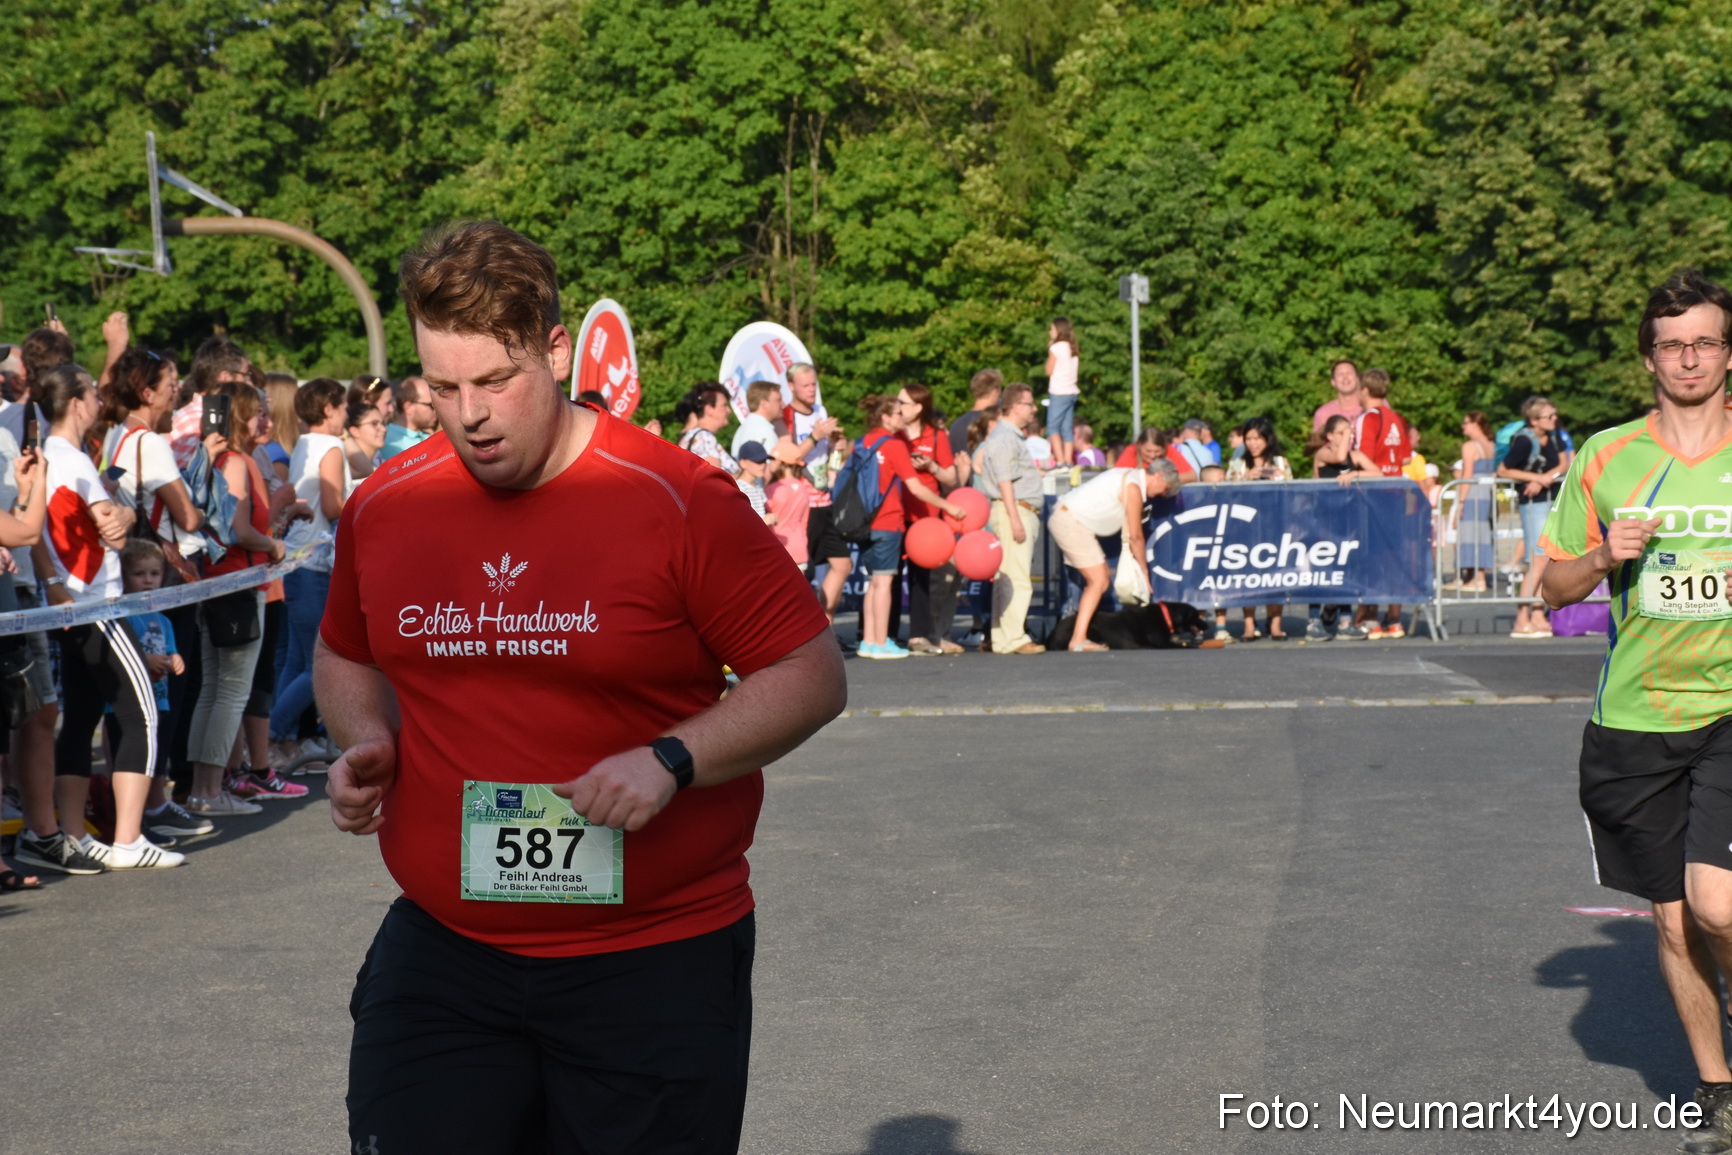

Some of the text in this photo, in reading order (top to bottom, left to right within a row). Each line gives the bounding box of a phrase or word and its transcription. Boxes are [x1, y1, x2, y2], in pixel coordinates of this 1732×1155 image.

[401, 453, 427, 469] JAKO
[1182, 533, 1360, 570] Fischer
[1199, 571, 1344, 590] AUTOMOBILE
[1660, 575, 1718, 600] 310
[1663, 601, 1682, 609] Lang
[398, 600, 600, 637] Echtes Handwerk
[426, 639, 567, 657] IMMER FRISCH
[486, 805, 546, 819] firmenlauf
[495, 827, 585, 869] 587
[500, 871, 582, 882] Feihl Andreas
[510, 883, 538, 891] Bäcker
[562, 884, 587, 892] GmbH
